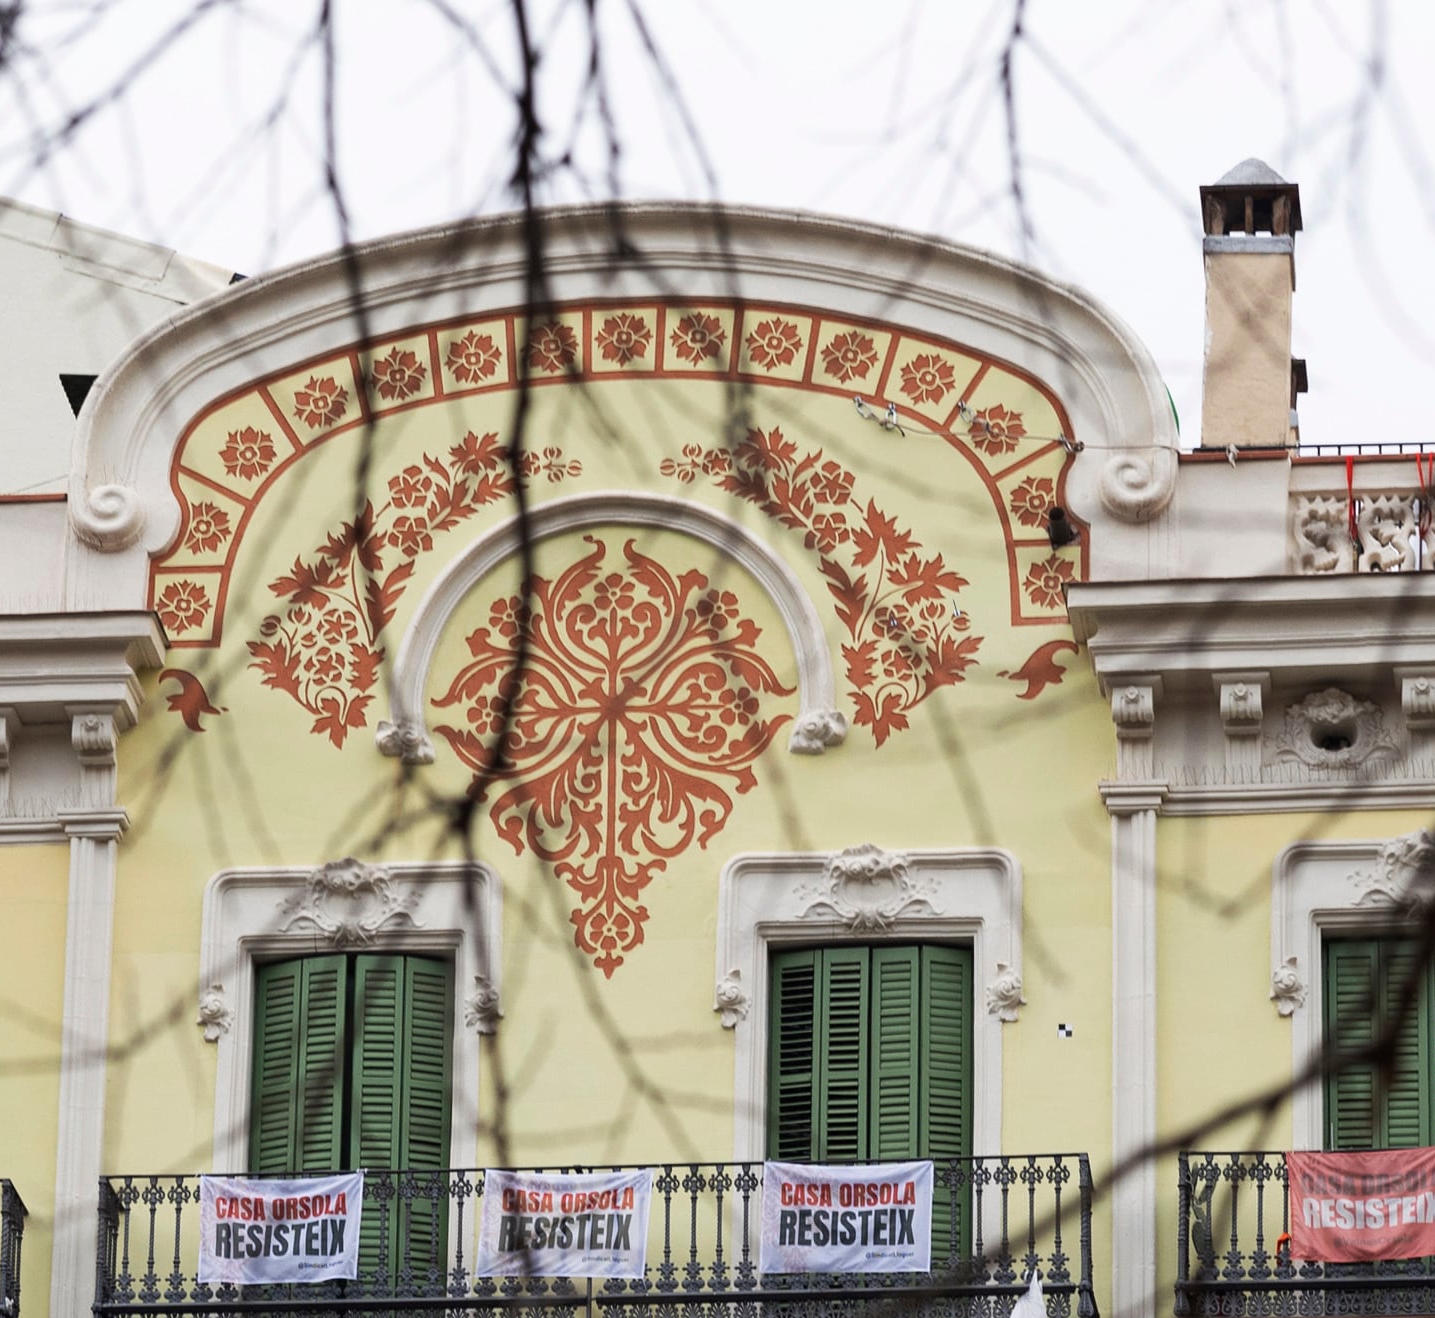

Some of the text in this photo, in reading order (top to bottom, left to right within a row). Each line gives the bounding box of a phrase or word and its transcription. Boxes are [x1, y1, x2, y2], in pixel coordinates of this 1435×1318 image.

[215, 1192, 347, 1221] CASA ORSOLA
[502, 1187, 634, 1213] CASA ORSOLA
[781, 1181, 916, 1207] CASA ORSOLA
[215, 1219, 346, 1259] RESISTEIX
[498, 1213, 632, 1251] RESISTEIX
[779, 1208, 915, 1247] RESISTEIX
